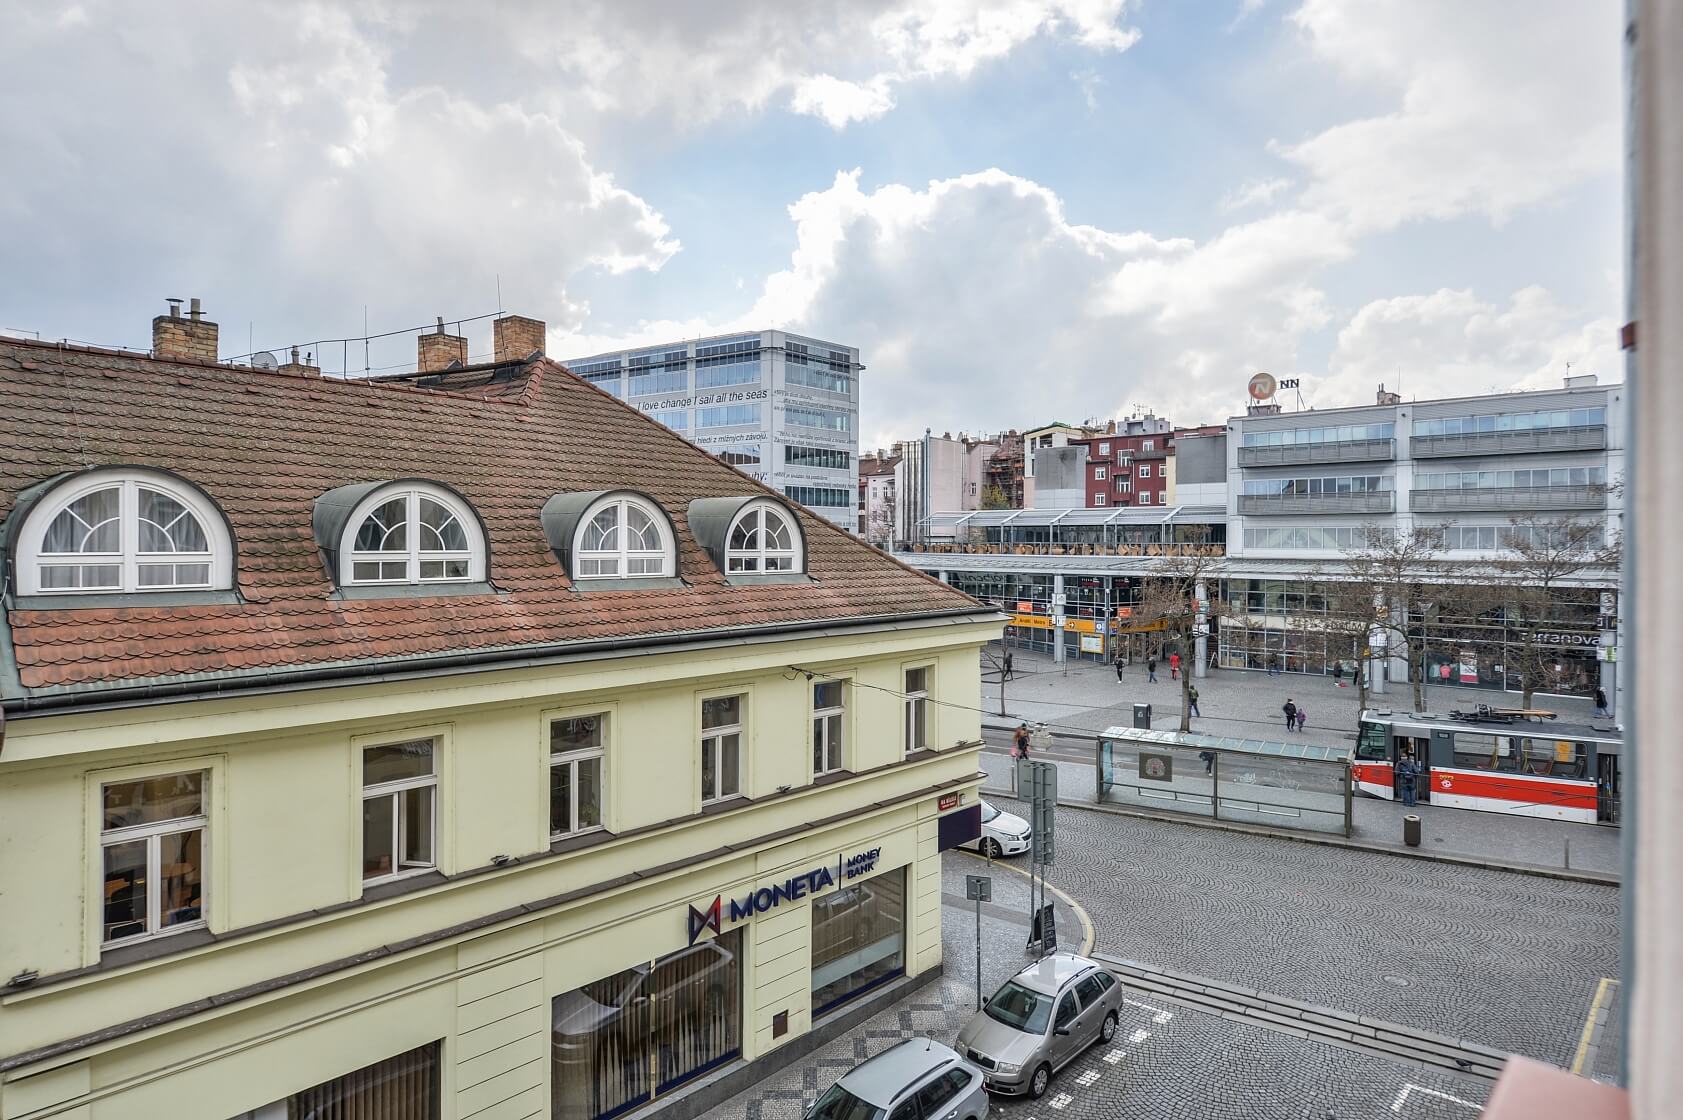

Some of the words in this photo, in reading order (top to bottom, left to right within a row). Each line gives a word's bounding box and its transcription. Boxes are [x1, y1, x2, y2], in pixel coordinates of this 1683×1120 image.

[1280, 379, 1299, 389] NN
[642, 400, 659, 410] love
[661, 398, 692, 408] change
[699, 394, 715, 405] sail
[716, 393, 727, 403] all
[728, 391, 743, 402] the
[745, 390, 768, 400] seas
[847, 847, 881, 868] MONEY
[847, 861, 875, 879] BANK
[731, 867, 834, 922] MONETA
